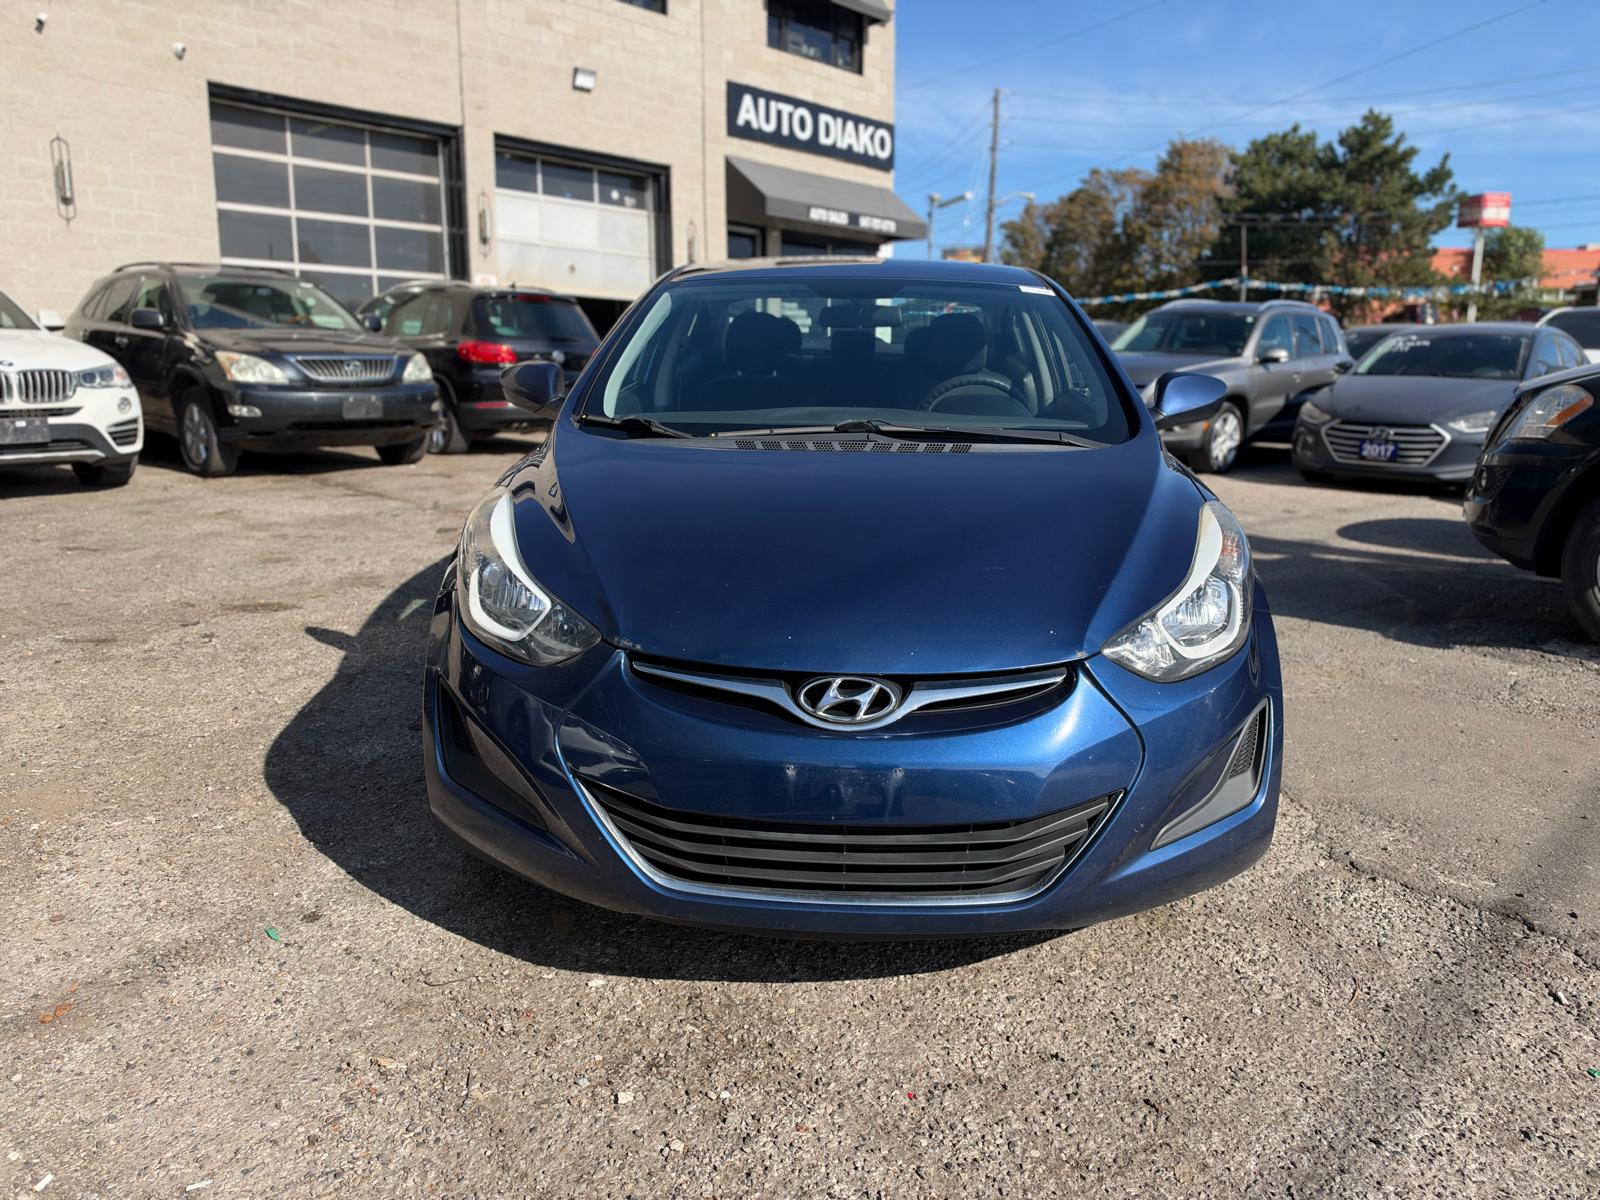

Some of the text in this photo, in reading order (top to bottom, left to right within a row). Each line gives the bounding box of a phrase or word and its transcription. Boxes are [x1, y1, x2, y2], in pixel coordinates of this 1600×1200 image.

[736, 93, 893, 160] AUTO DIAKO
[1361, 442, 1395, 458] 2017
